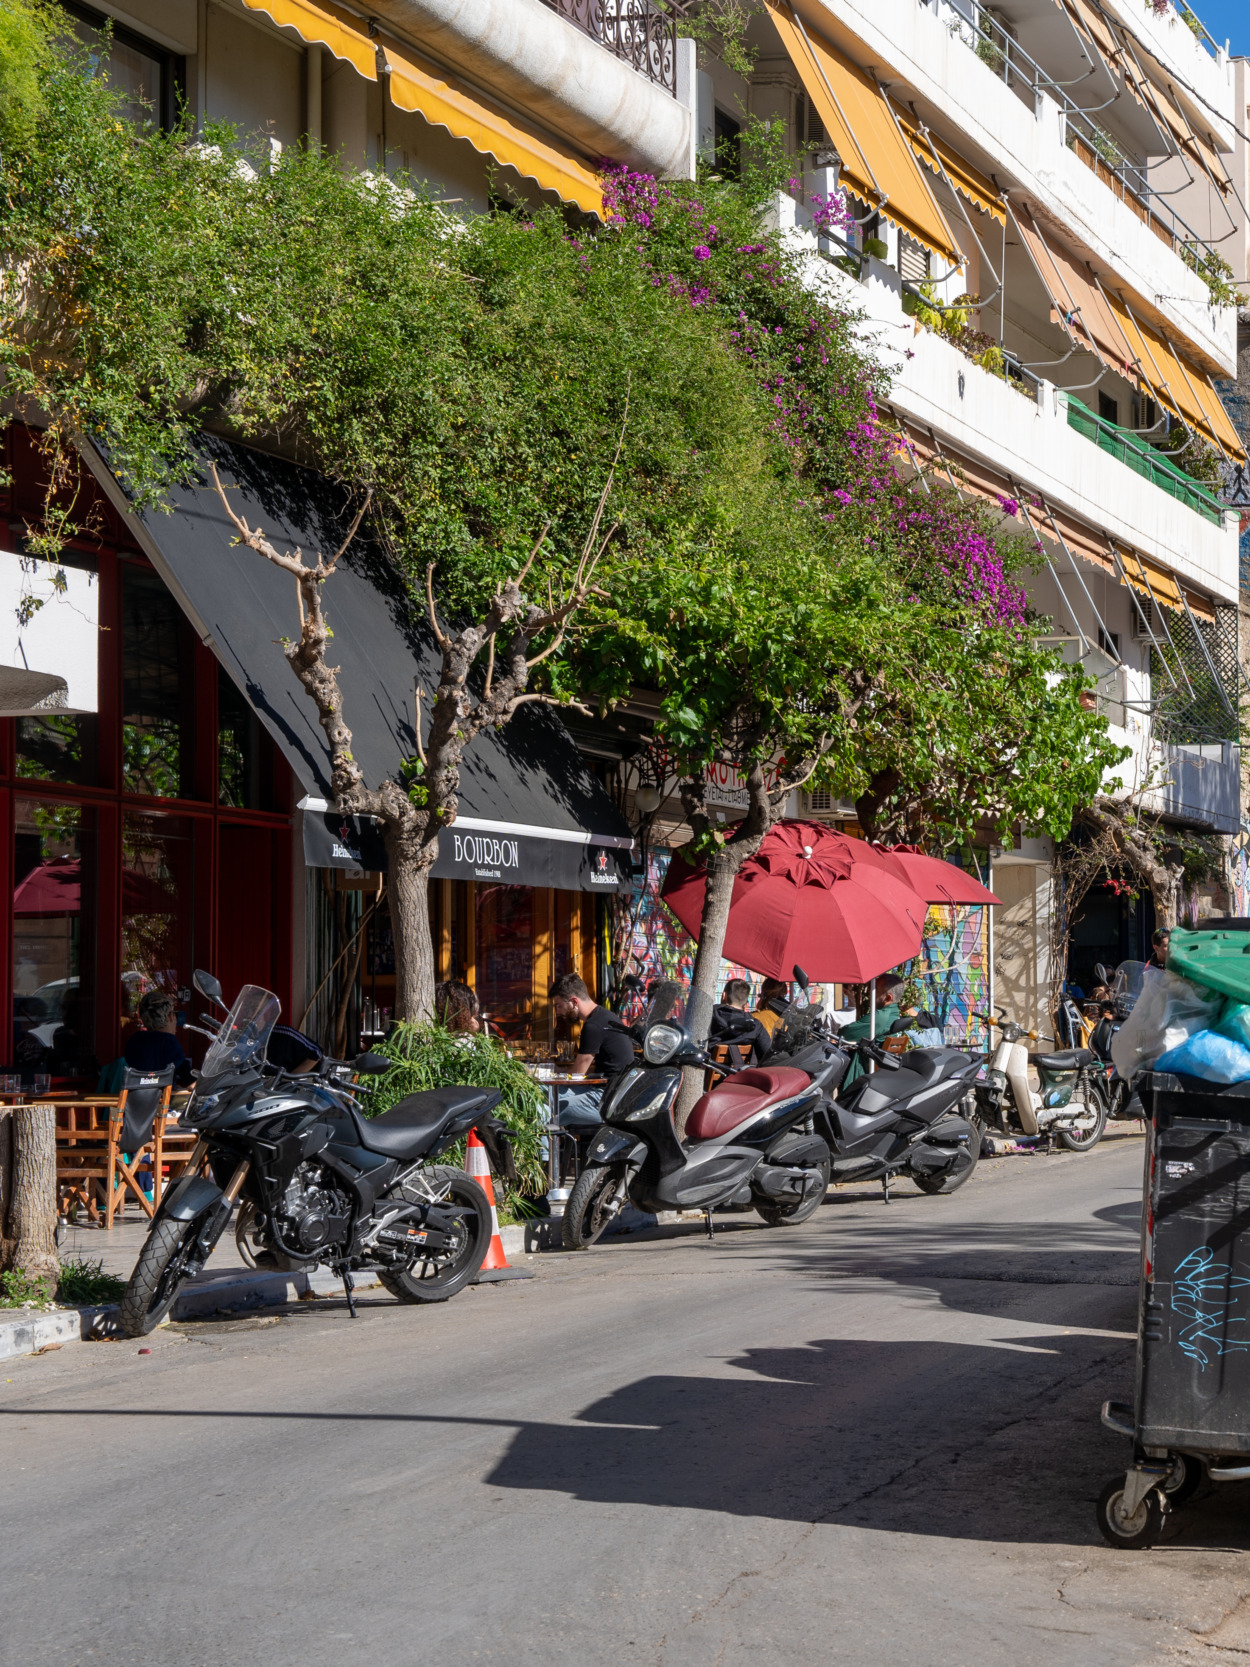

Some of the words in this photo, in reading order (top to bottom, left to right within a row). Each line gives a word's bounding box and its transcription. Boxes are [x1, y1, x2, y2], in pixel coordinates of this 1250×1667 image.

[728, 788, 751, 805] ΣΤΑΘΜΕ
[332, 843, 362, 859] Heineken
[453, 834, 519, 868] BOURBON
[590, 871, 619, 884] Heineken
